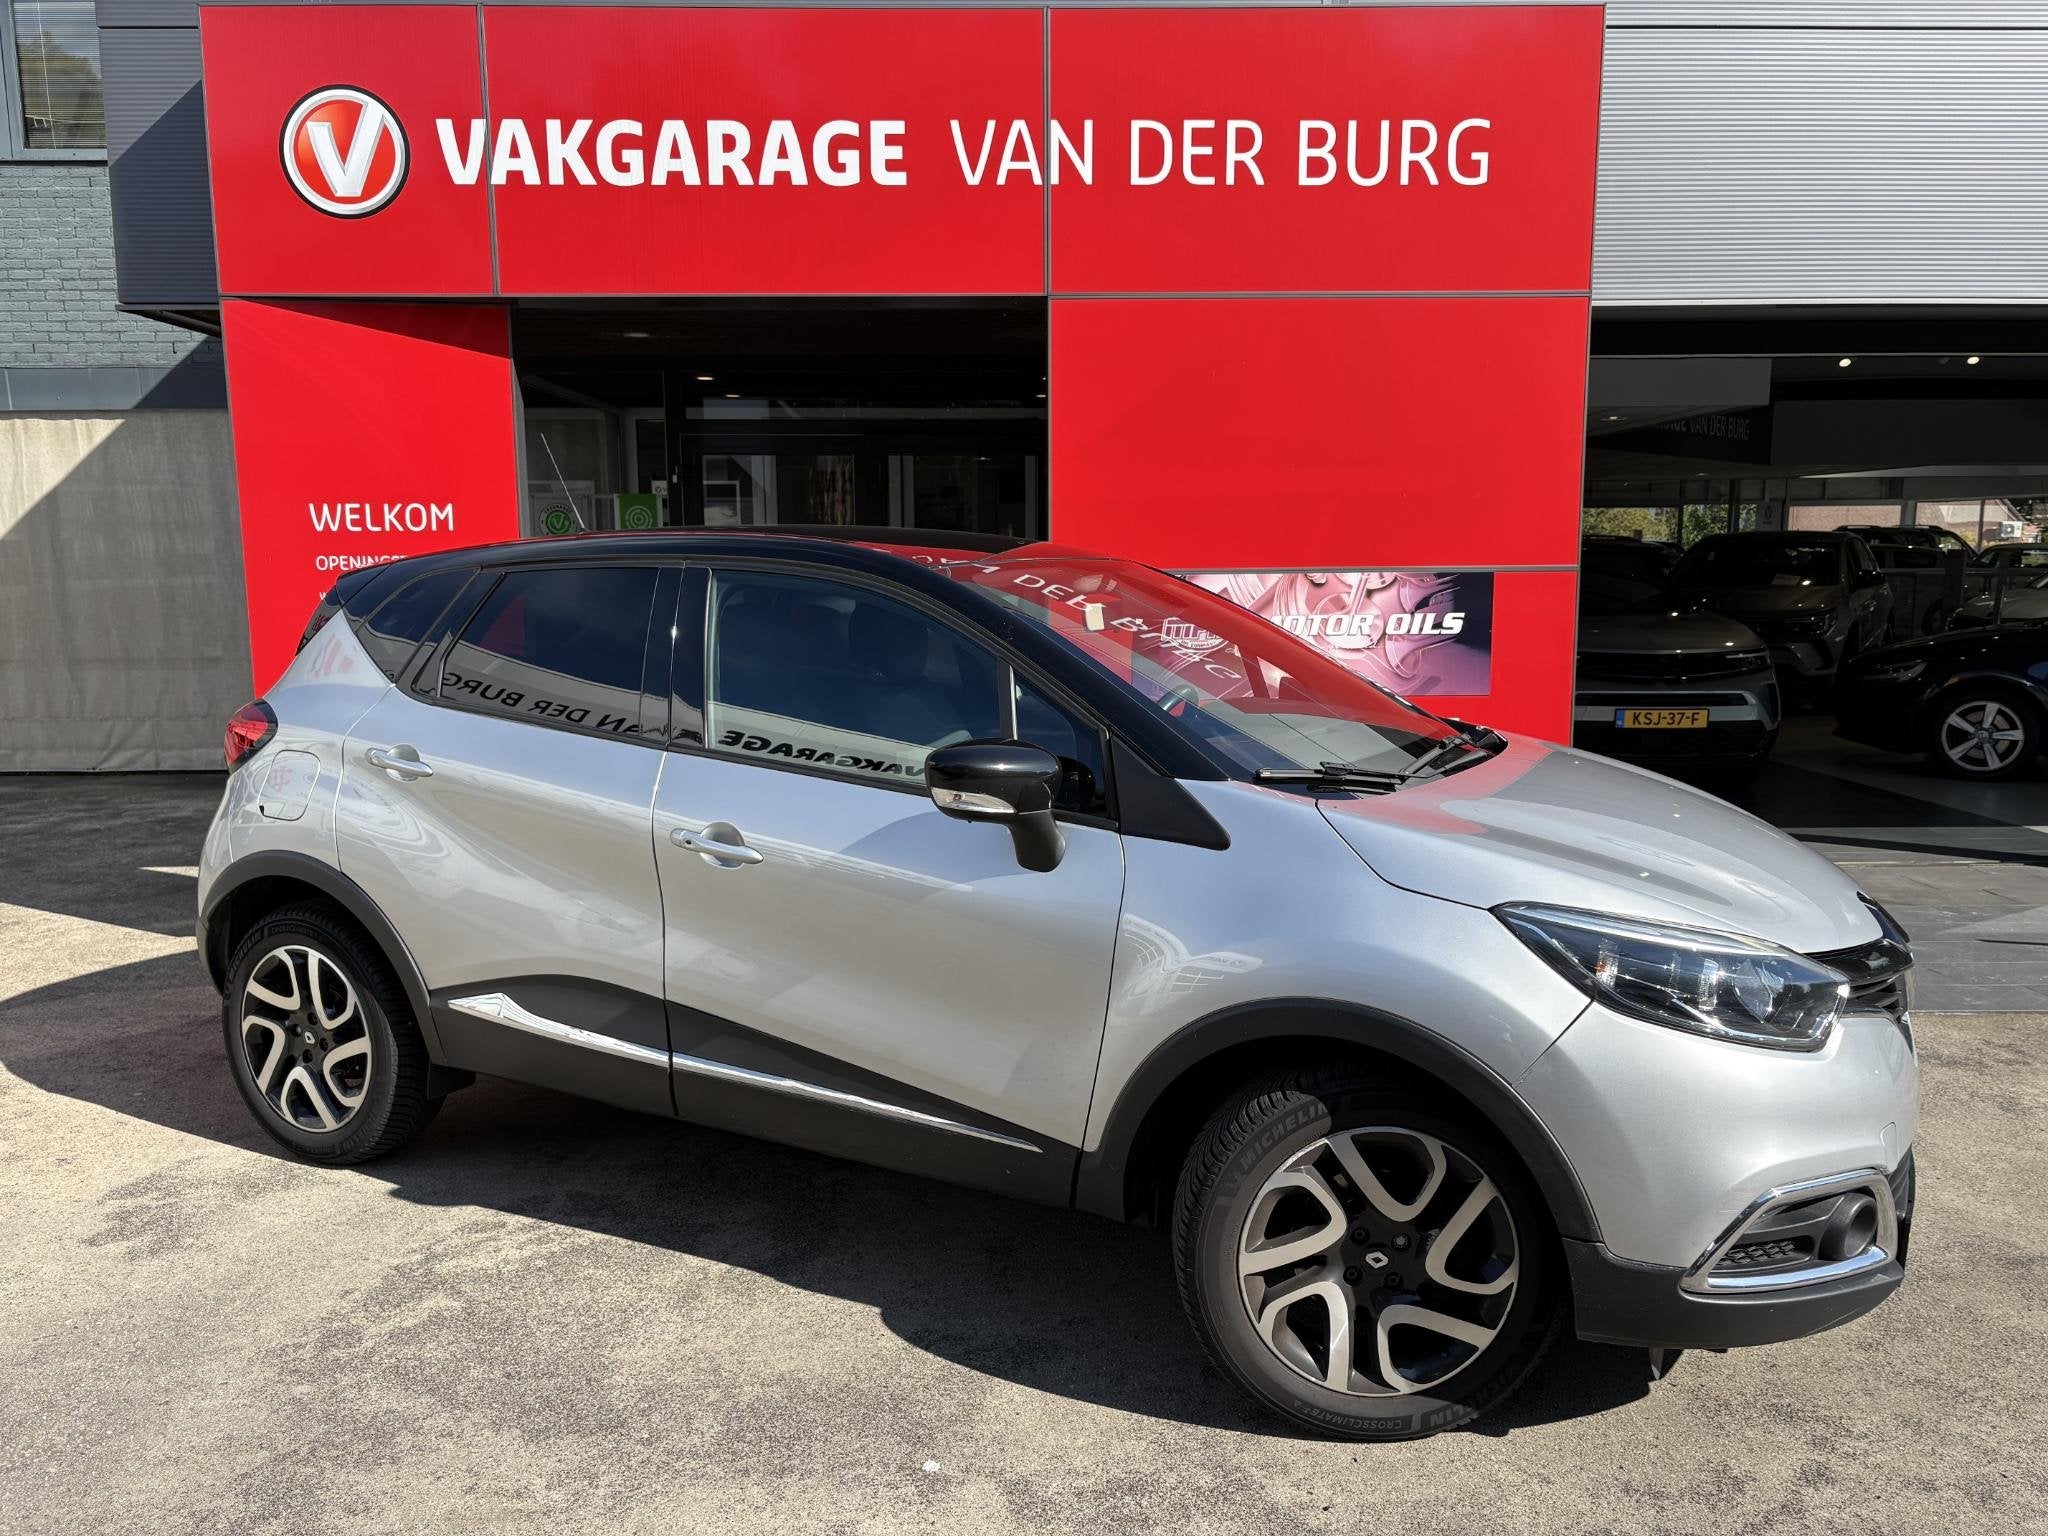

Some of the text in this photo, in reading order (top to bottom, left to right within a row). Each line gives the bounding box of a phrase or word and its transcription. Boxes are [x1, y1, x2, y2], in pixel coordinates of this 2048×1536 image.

[436, 117, 1491, 187] VAKGARAGE VAN DER BURG
[308, 502, 455, 532] WELKOM
[1385, 612, 1466, 635] OILS
[1632, 712, 1700, 726] KSJ-37-F
